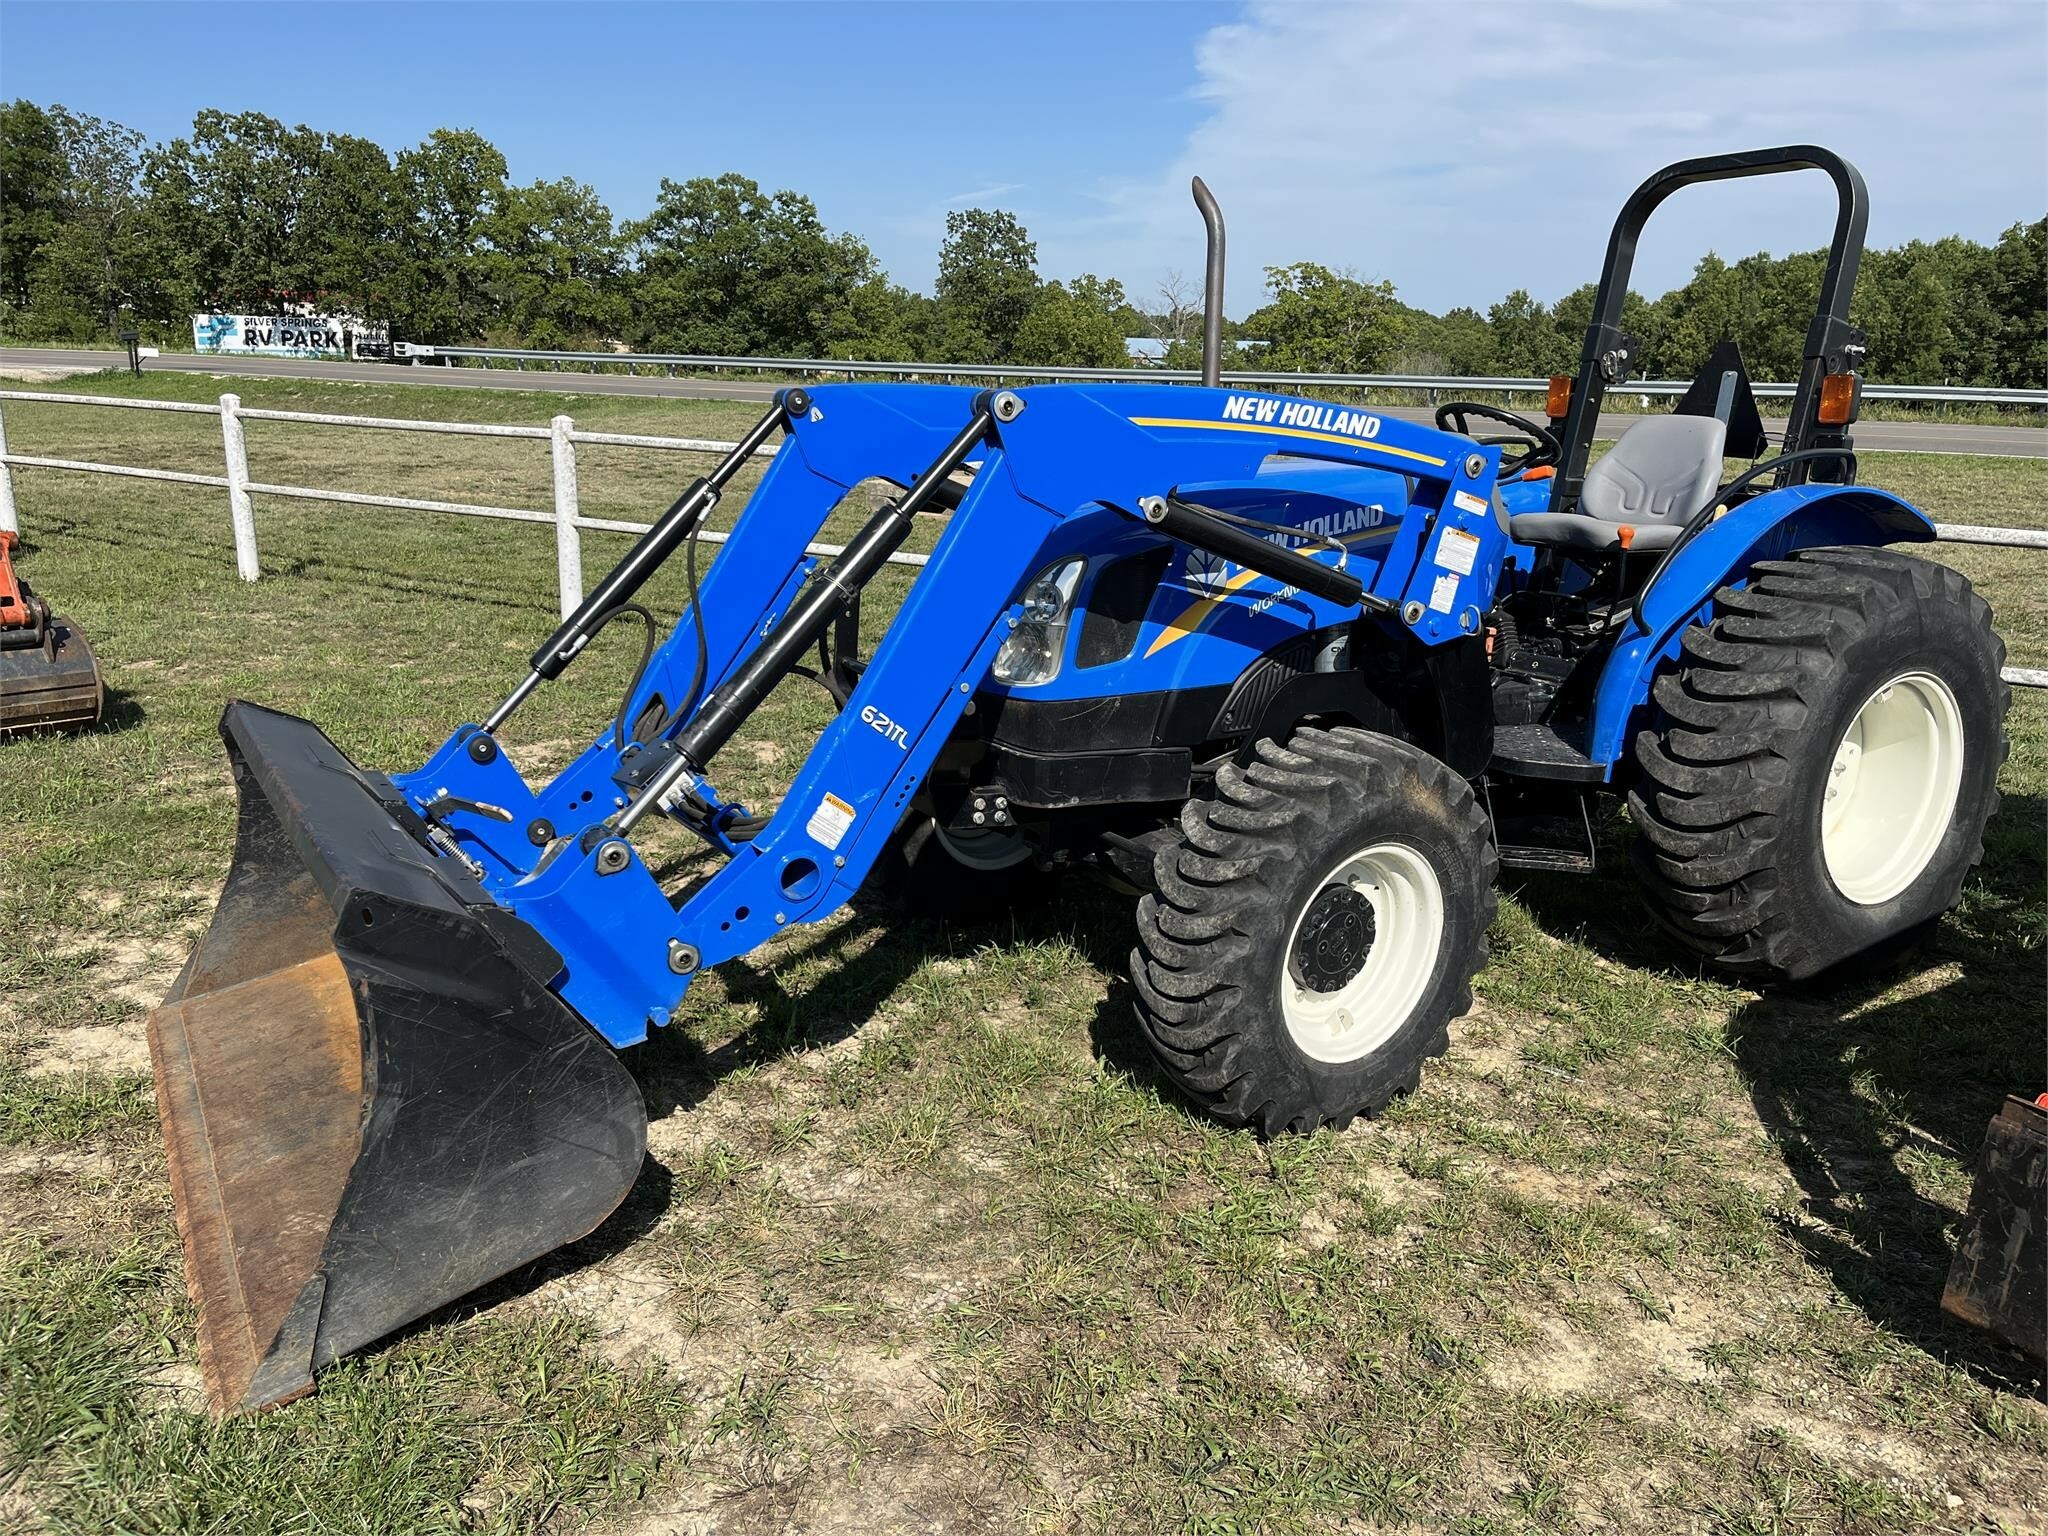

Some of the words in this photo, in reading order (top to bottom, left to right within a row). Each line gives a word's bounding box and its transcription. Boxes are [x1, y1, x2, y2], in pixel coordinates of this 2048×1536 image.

[244, 317, 278, 328] SILVER
[281, 317, 328, 328] SPRINGS
[244, 329, 273, 347] RV
[281, 329, 340, 349] PARK
[1222, 395, 1281, 423] NEW
[1279, 402, 1381, 439] HOLLAND
[861, 705, 908, 750] 621TL
